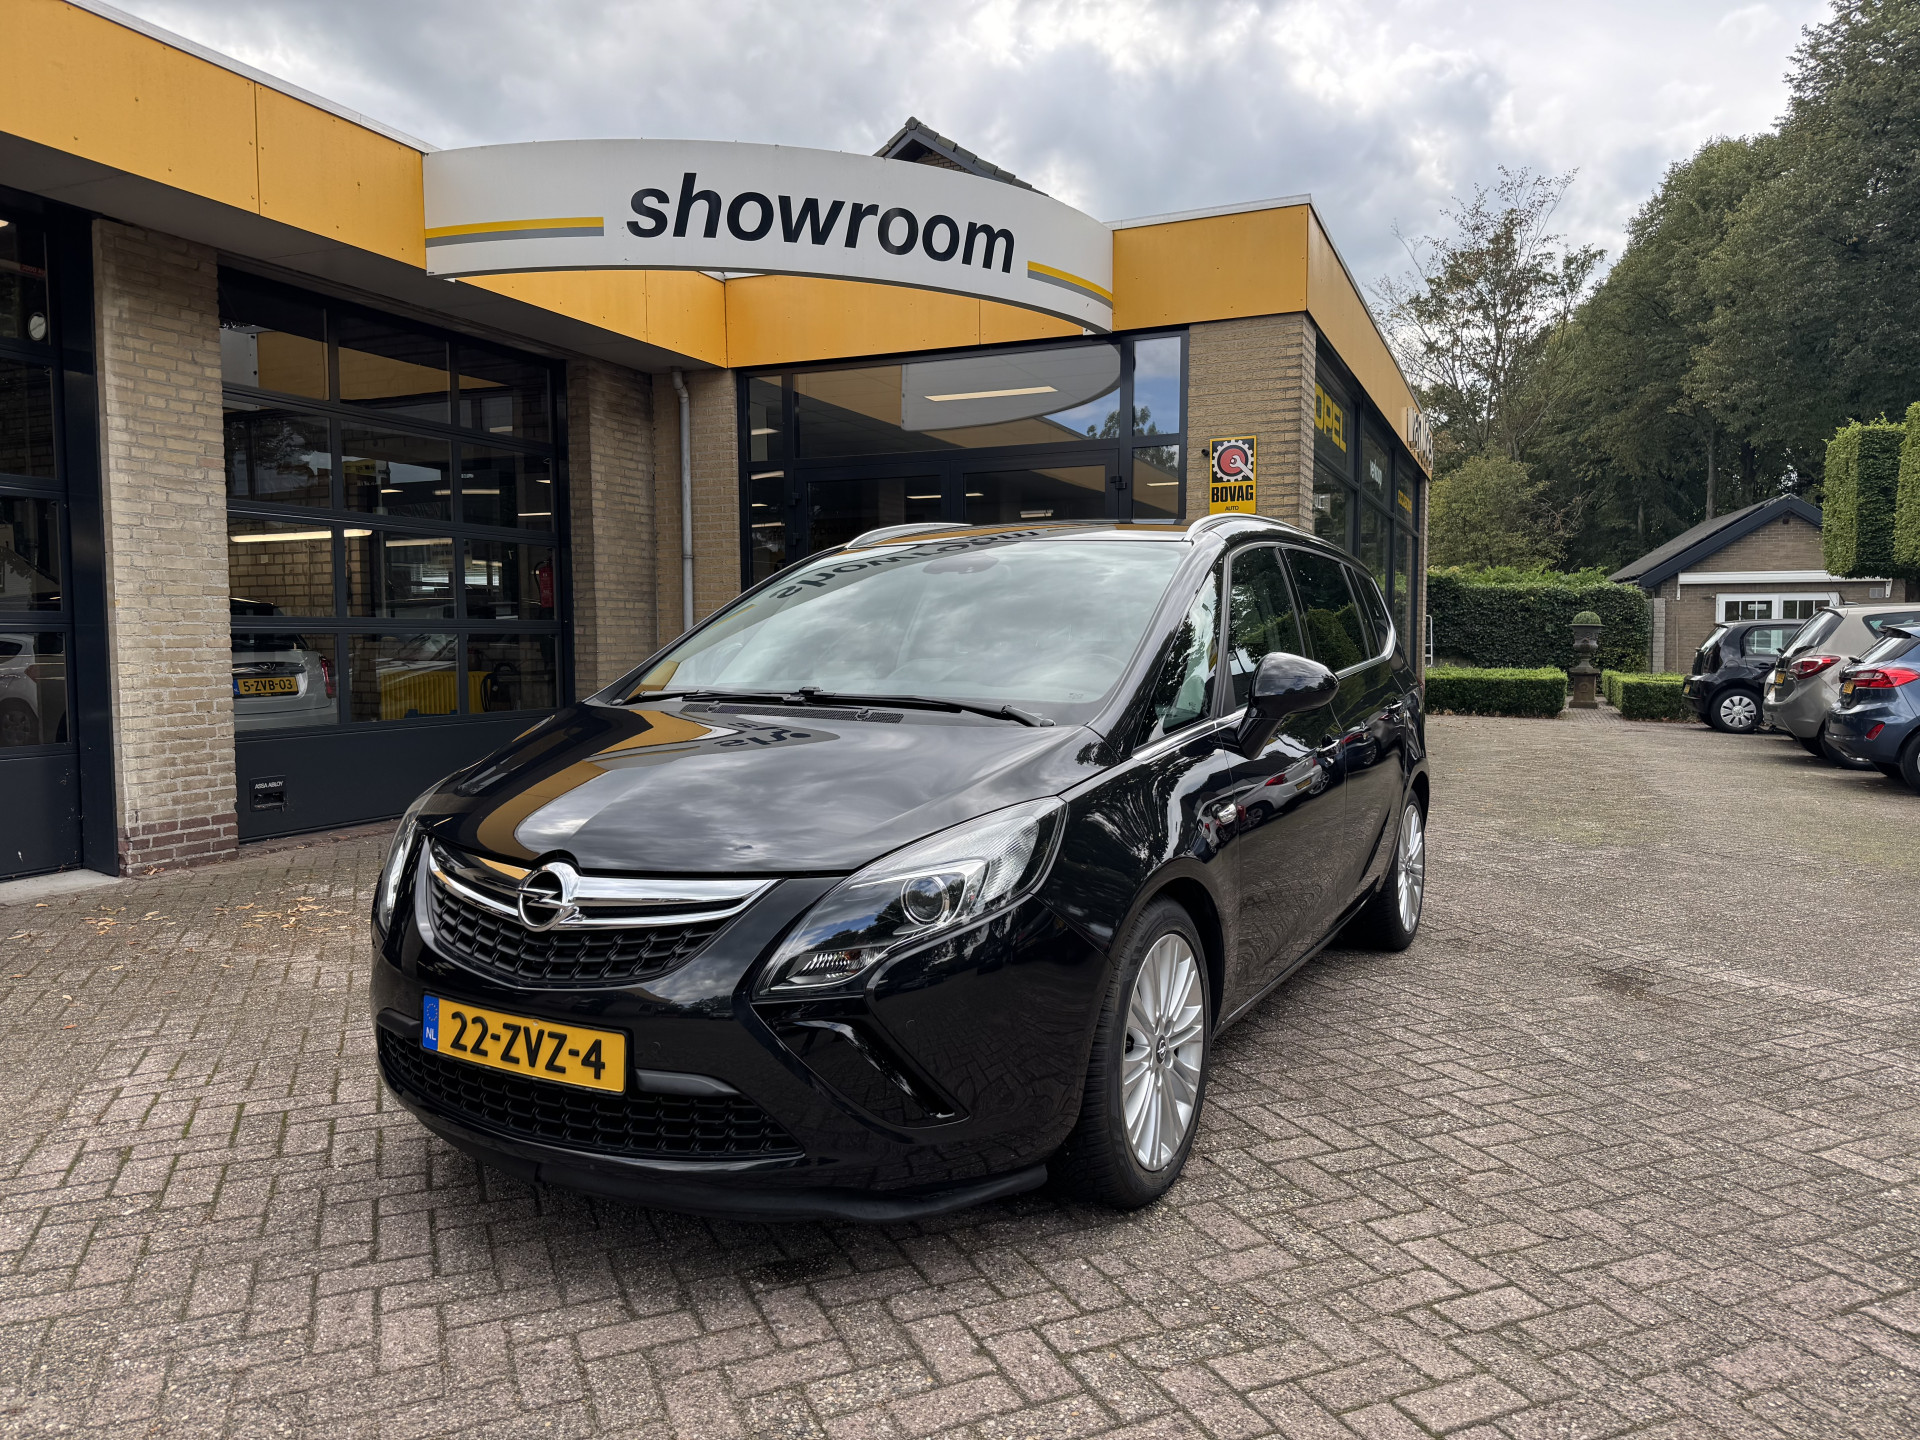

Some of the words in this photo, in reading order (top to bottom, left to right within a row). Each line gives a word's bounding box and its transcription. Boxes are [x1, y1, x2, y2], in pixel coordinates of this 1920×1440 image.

[625, 171, 1016, 274] showroom
[1314, 382, 1347, 454] OPEL
[1211, 484, 1254, 503] BOVAG
[242, 679, 294, 692] 5-ZVB-03
[254, 782, 268, 790] ASSA
[268, 780, 284, 788] ABLOY
[425, 1026, 437, 1041] NL
[449, 1011, 606, 1080] 22-ZVZ-4
